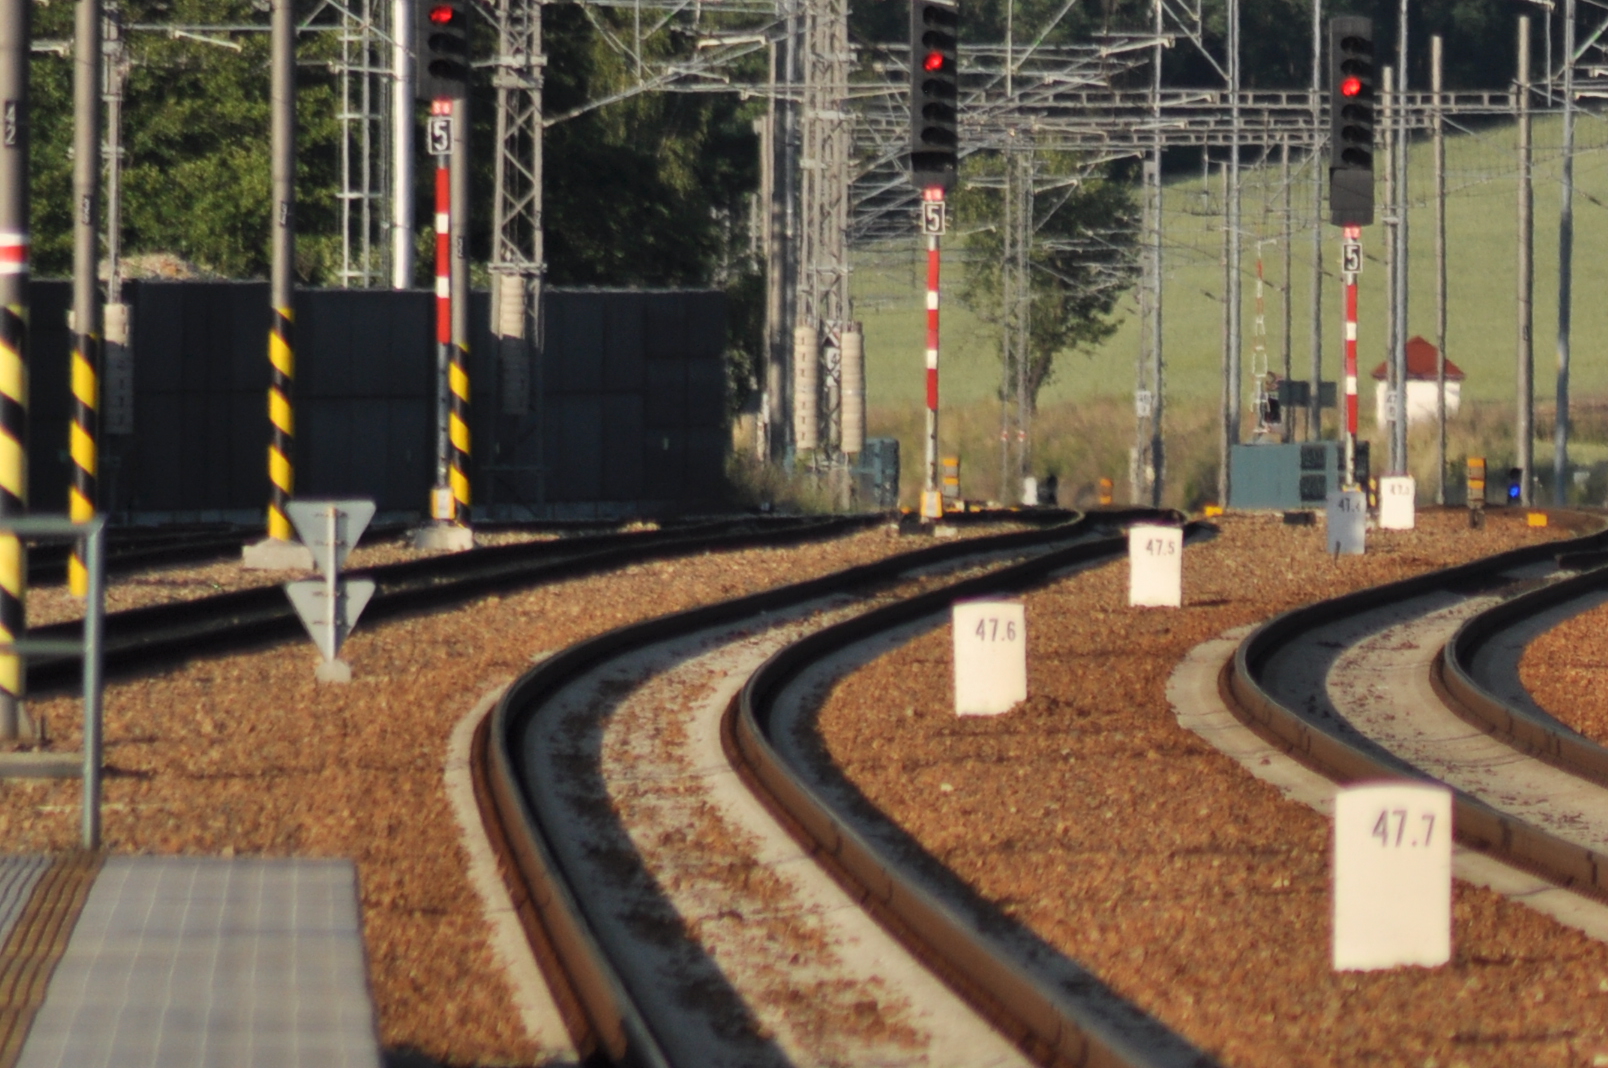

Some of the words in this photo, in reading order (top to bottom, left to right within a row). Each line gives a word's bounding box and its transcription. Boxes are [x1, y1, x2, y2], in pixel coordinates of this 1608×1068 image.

[434, 121, 448, 151] 5
[927, 204, 940, 232] 5
[1346, 245, 1359, 270] 5
[1146, 538, 1175, 556] 47.5
[975, 618, 1016, 642] 47.6
[1371, 808, 1436, 848] 47.7
